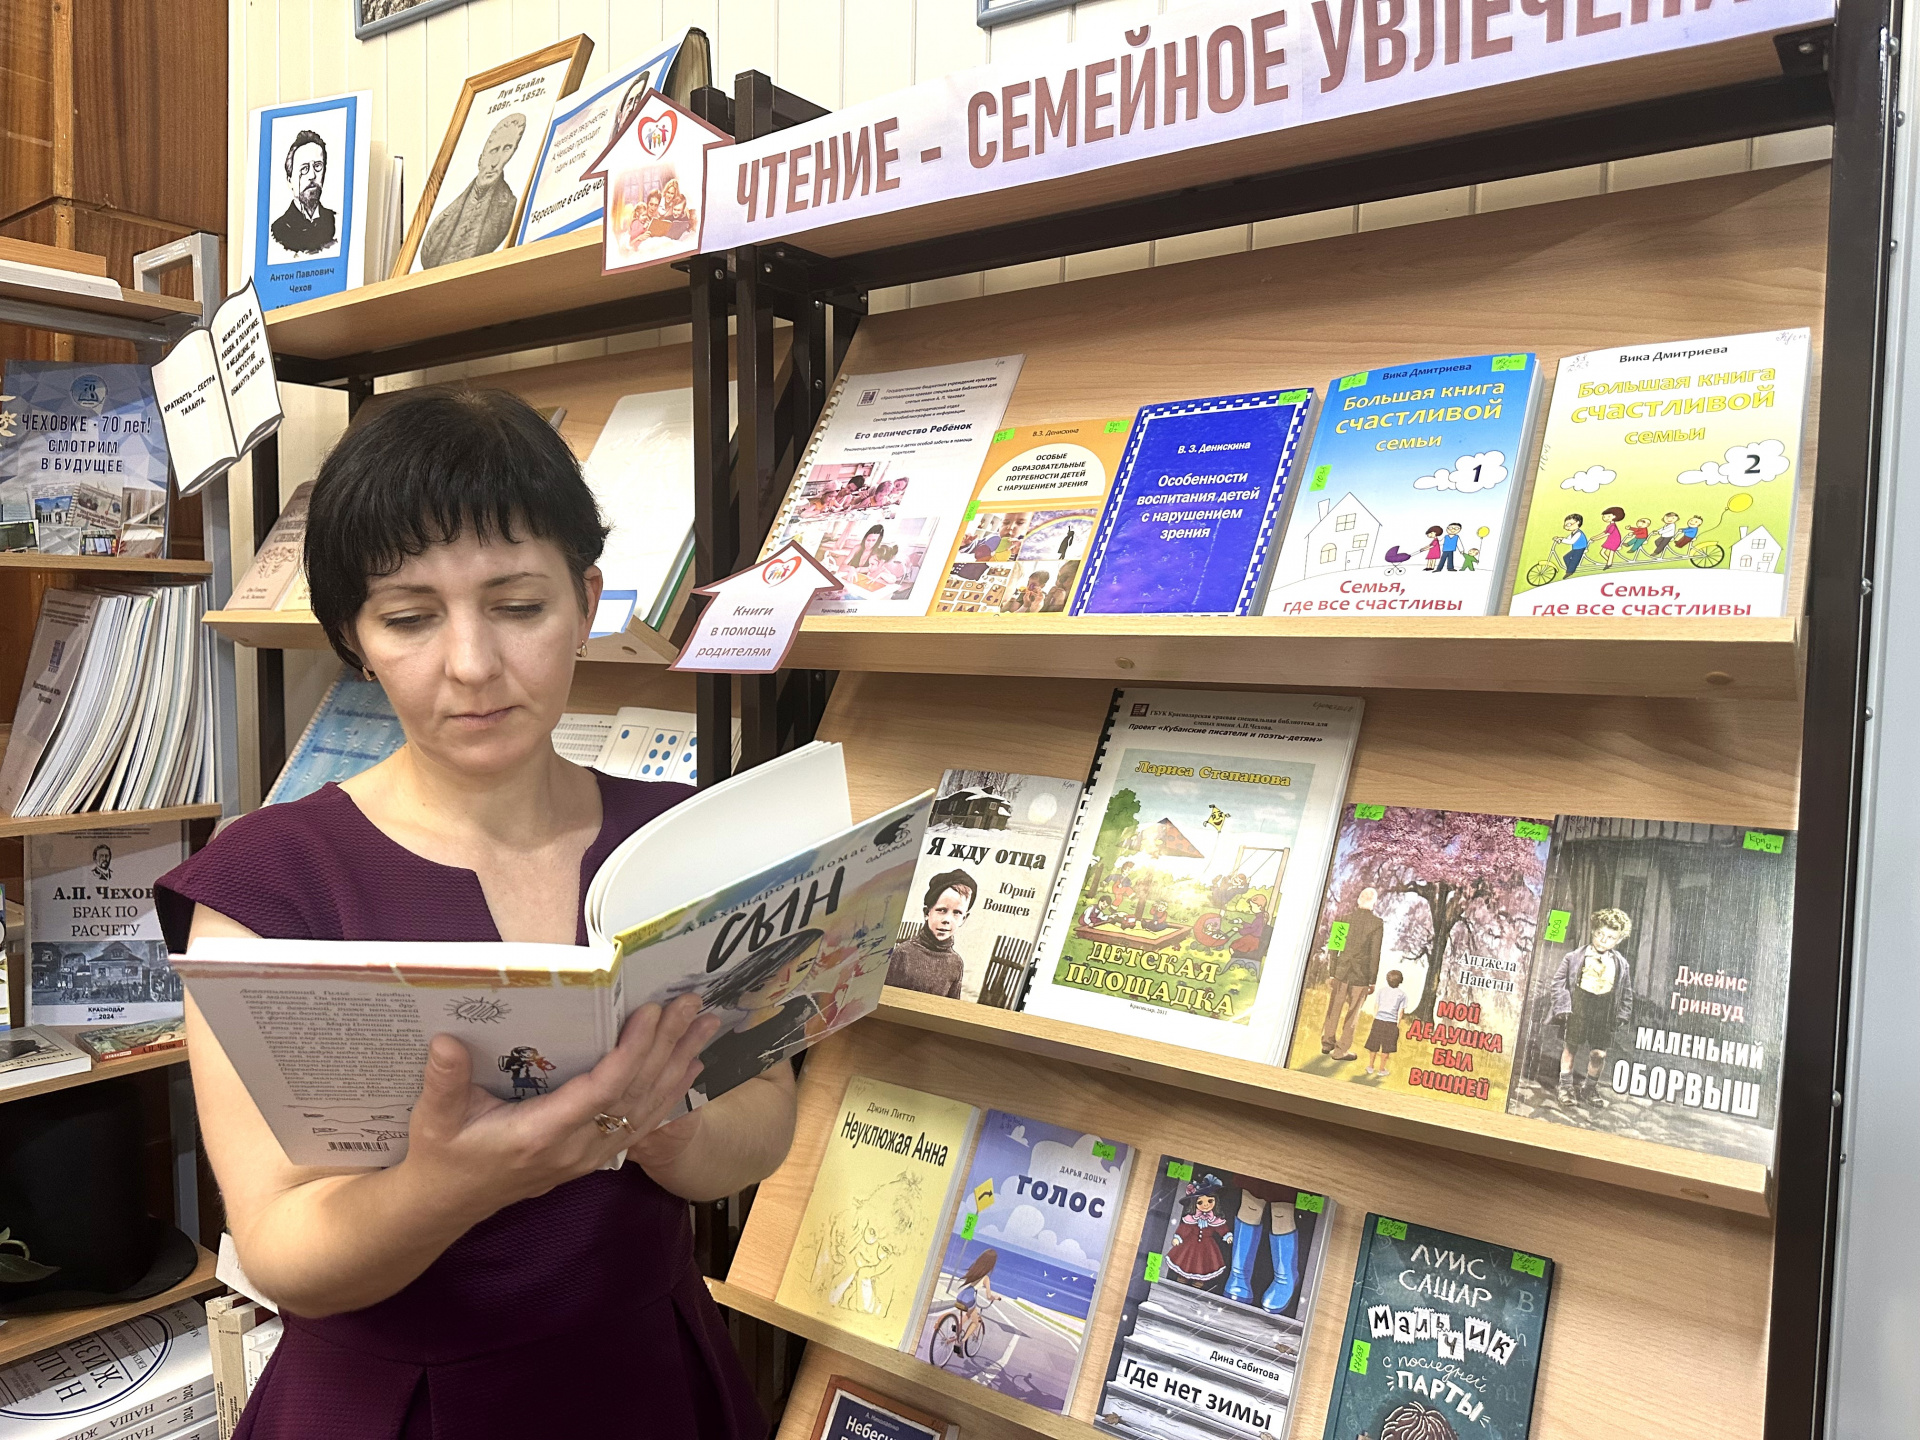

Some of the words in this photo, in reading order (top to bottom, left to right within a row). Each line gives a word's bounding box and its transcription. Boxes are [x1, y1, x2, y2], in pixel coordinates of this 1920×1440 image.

[497, 86, 514, 100] Луи
[515, 76, 546, 93] Брайль
[487, 100, 512, 115] 1809г.
[521, 88, 547, 103] 1852г.
[736, 116, 901, 223] ЧТЕНИЕ
[967, 9, 1289, 169] СЕМЕЙНОЕ
[566, 193, 573, 206] в
[572, 181, 592, 203] себе
[269, 271, 294, 284] Антон
[295, 265, 336, 281] Павлович
[288, 281, 313, 295] Чехов
[1619, 352, 1650, 364] Вика
[1652, 346, 1728, 362] Дмитриева
[1382, 367, 1408, 381] Вика
[1408, 363, 1472, 378] Дмитриева
[1577, 375, 1692, 399] Большая
[1697, 367, 1776, 387] книга
[163, 390, 193, 414] КРАТКОСТЬ
[197, 374, 216, 394] СЕСТРА
[1342, 388, 1434, 412] Большая
[1440, 382, 1506, 398] книга
[1570, 384, 1776, 423] счастливой
[180, 396, 207, 417] ТАЛАНТА.
[1334, 398, 1503, 434] счастливой
[21, 413, 87, 433] ЧЕХОВКЕ
[102, 415, 120, 433] 70
[123, 417, 152, 434] лет!
[854, 431, 871, 440] Его
[872, 427, 928, 439] величество
[929, 421, 973, 434] Ребёнок
[1032, 429, 1045, 438] В.З.
[1045, 428, 1080, 437] Денискина
[1375, 435, 1442, 452] семьи
[1624, 427, 1706, 445] семьи
[48, 439, 118, 455] СМОТРИМ
[1035, 452, 1068, 461] ОСОБЫЕ
[1178, 445, 1188, 455] В.
[1188, 444, 1197, 454] З.
[1198, 439, 1251, 454] Денискина
[41, 457, 51, 471] В
[54, 458, 124, 475] БУДУЩЕЕ
[1011, 460, 1086, 472] ОБРАЗОВАТЕЛЬНЫЕ
[1472, 464, 1483, 483] 1
[1744, 454, 1761, 474] 2
[1003, 482, 1057, 491] НАРУШЕНИЕМ
[1057, 480, 1088, 489] ЗРЕНИЯ
[1005, 472, 1059, 482] ПОТРЕБНОСТИ
[1060, 469, 1086, 479] ДЕТЕЙ
[1157, 471, 1248, 487] Особенности
[1136, 488, 1216, 506] воспитания
[1217, 487, 1260, 503] детей
[1141, 511, 1150, 523] с
[1151, 506, 1242, 524] нарушением
[1159, 526, 1211, 542] зрения
[1339, 580, 1406, 595] Семья,
[1600, 582, 1681, 600] Семья,
[733, 605, 774, 617] Книги
[1283, 599, 1314, 613] где
[1317, 599, 1350, 611] все
[1356, 598, 1463, 611] счастливы
[1532, 604, 1570, 617] где
[1575, 603, 1615, 616] все
[1621, 603, 1752, 617] счастливы
[710, 627, 719, 637] в
[720, 625, 776, 639] помощь
[695, 645, 772, 659] родителям
[1128, 723, 1156, 731] Проект
[1157, 725, 1207, 735] «Кубанские
[1207, 729, 1248, 738] писатели
[1257, 732, 1323, 744] поэты-детям»
[1135, 760, 1194, 778] Лариса
[1199, 766, 1291, 787] Степанова
[926, 836, 947, 857] Я
[947, 843, 992, 866] жду
[995, 849, 1048, 870] отца
[52, 886, 92, 900] А.П.
[682, 883, 785, 936] Алехандро
[792, 843, 868, 885] Паломас
[998, 881, 1037, 900] Юрий
[72, 905, 111, 918] БРАК
[115, 905, 138, 918] ПО
[705, 865, 846, 974] СЫН
[71, 924, 141, 937] РАСЧЕТУ
[1086, 940, 1221, 984] ДЕТСКАЯ
[1458, 951, 1517, 973] Анджела
[1458, 970, 1515, 993] Нанетти
[1674, 965, 1748, 993] Джеймс
[1064, 963, 1236, 1017] ПЛОЩАДКА
[88, 1006, 125, 1014] КРАСНОДАР
[1436, 1001, 1481, 1025] МОЙ
[1670, 991, 1745, 1024] Гринвуд
[1405, 1019, 1503, 1053] ДЕДУШКА
[1635, 1026, 1765, 1070] МАЛЕНЬКИЙ
[1432, 1048, 1474, 1072] БЫЛ
[1408, 1067, 1491, 1101] ВИШНЕЙ
[1612, 1059, 1761, 1119] ОБОРВЫШ
[866, 1102, 890, 1117] Джин
[890, 1106, 916, 1124] Литтл
[840, 1110, 912, 1159] Неуклюжая
[911, 1131, 949, 1167] Анна
[1059, 1165, 1083, 1178] ДАРЬЯ
[1083, 1172, 1107, 1185] ДОЦУК
[1411, 1244, 1487, 1281] ЛУИС
[1398, 1269, 1493, 1309] САШАР
[1209, 1349, 1235, 1368] Дина
[1236, 1357, 1280, 1382] Сабитова
[1382, 1355, 1392, 1368] с
[1397, 1356, 1487, 1394] последней
[1123, 1358, 1159, 1390] Где
[1163, 1376, 1203, 1404] нет
[1205, 1394, 1273, 1431] зимы
[1396, 1370, 1486, 1422] ПАРТЫ
[110, 1403, 154, 1428] НАША
